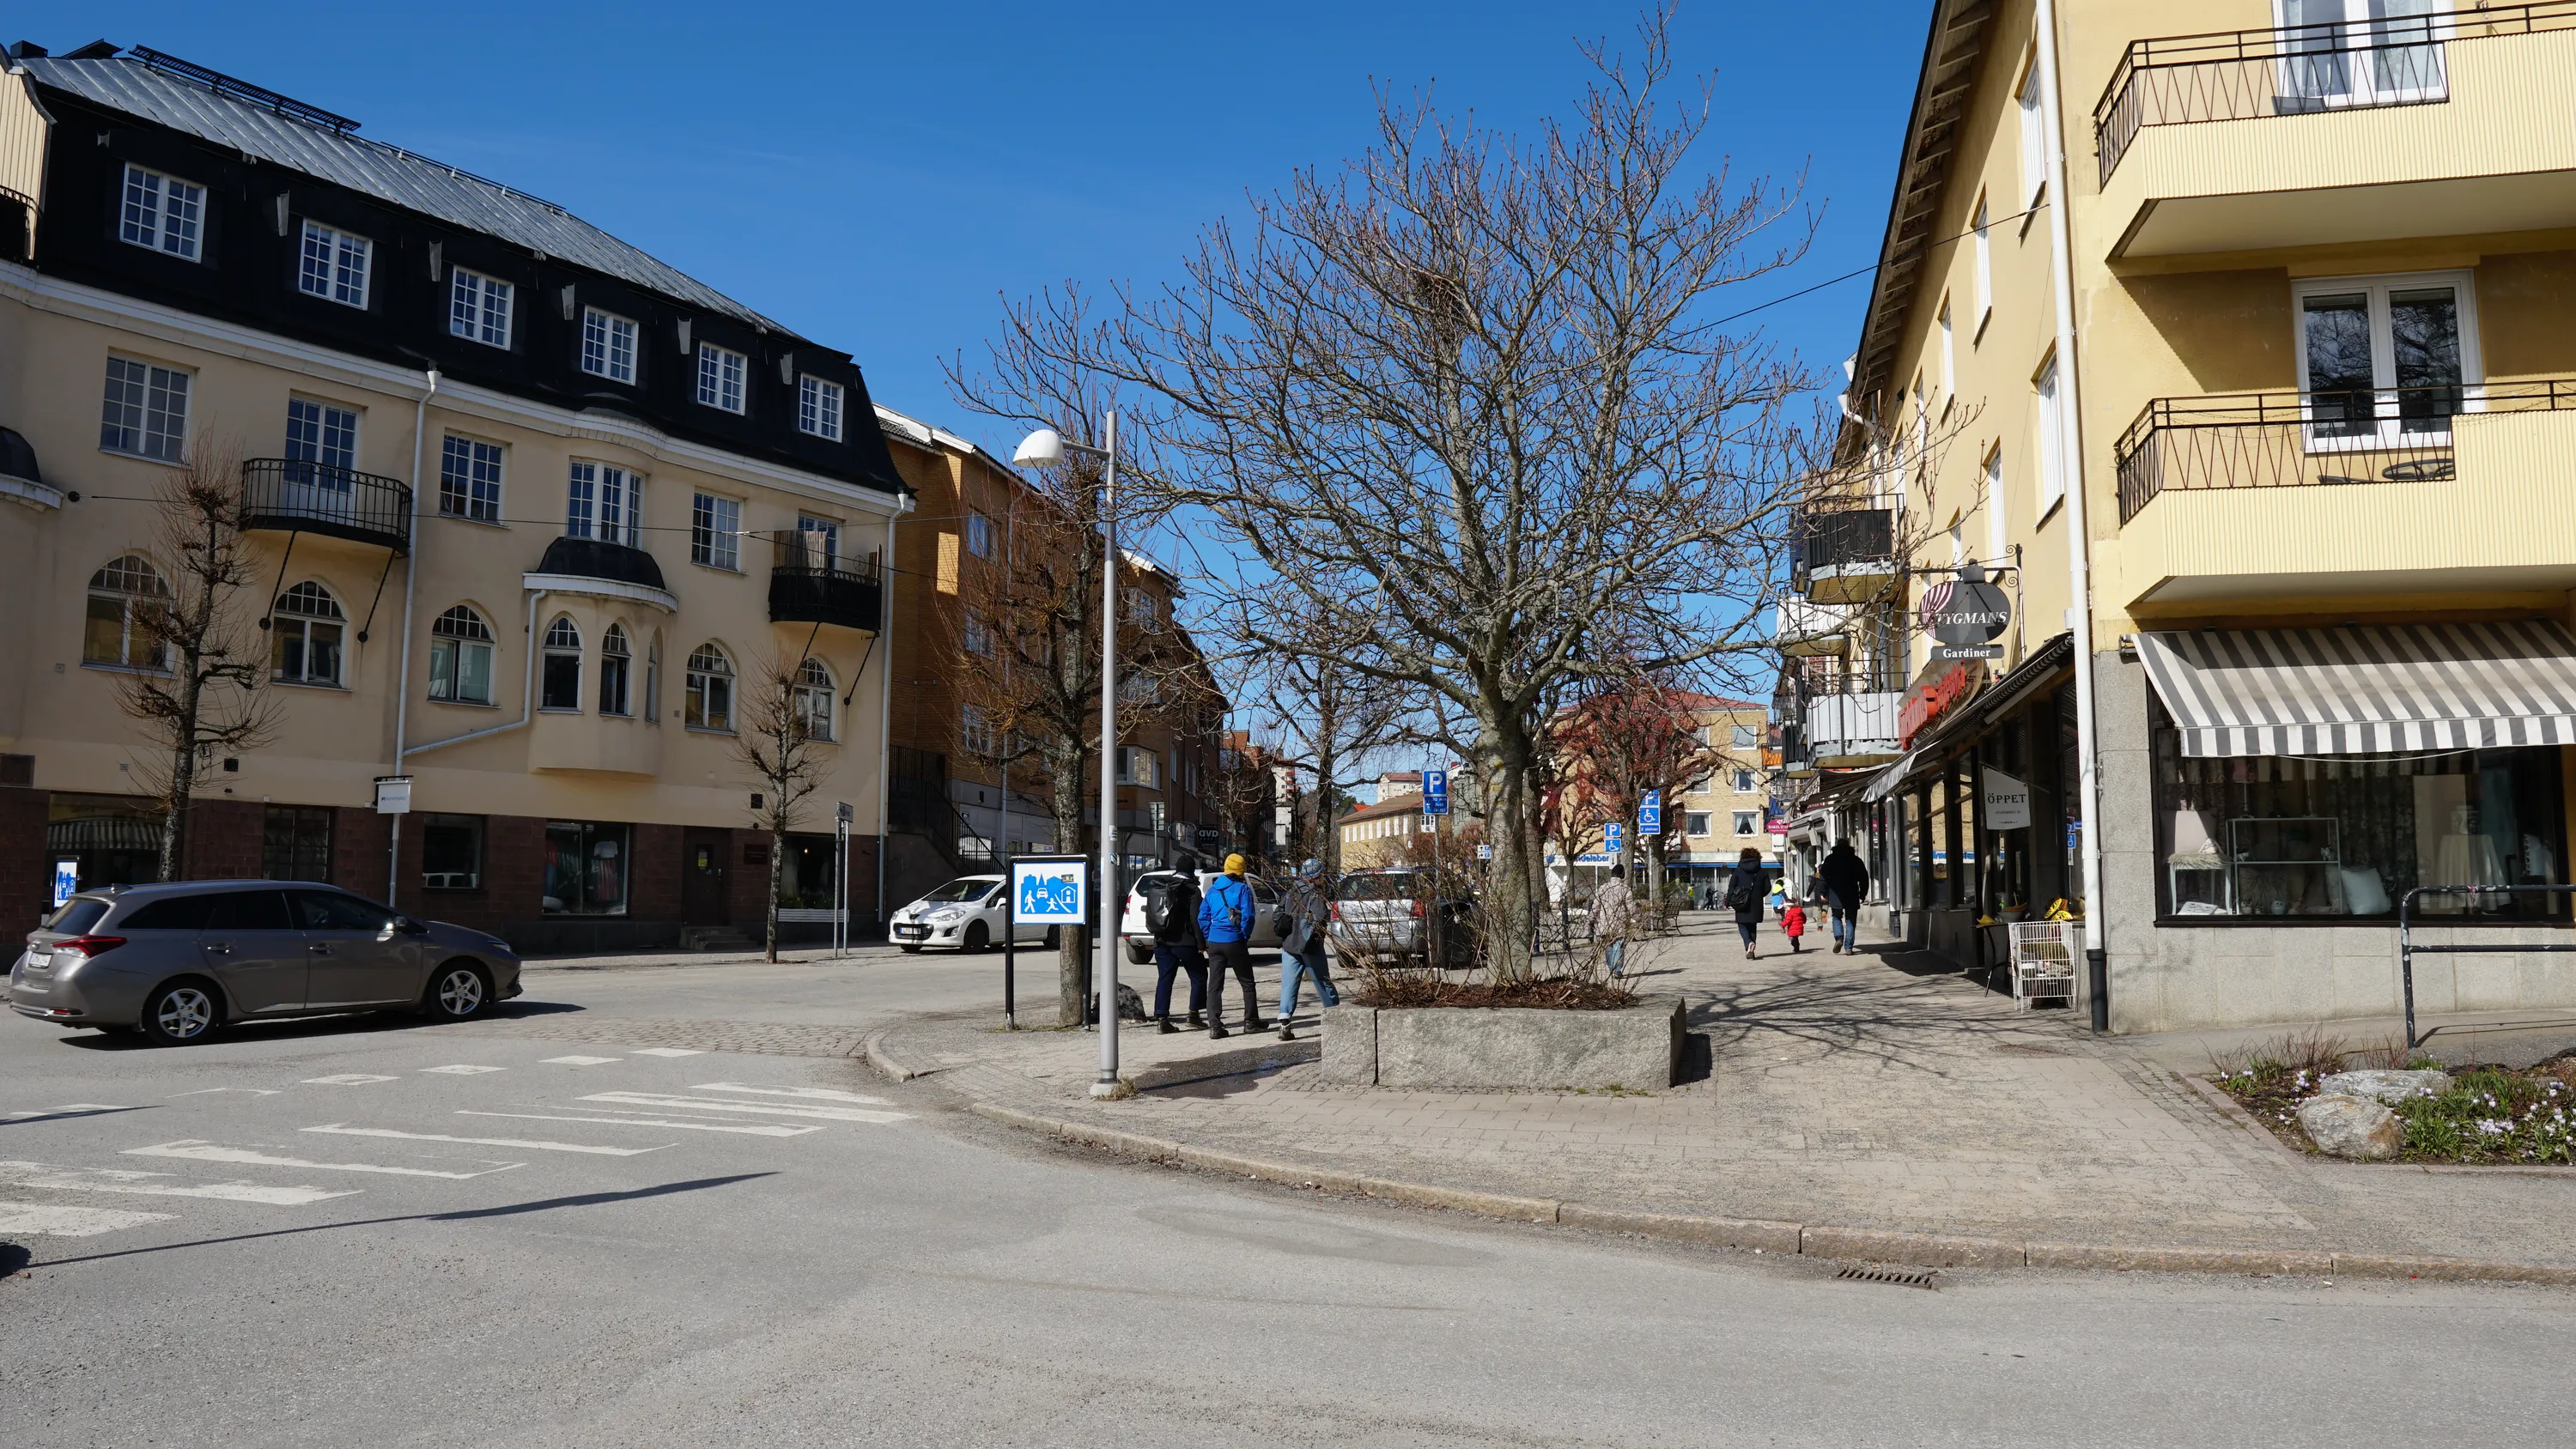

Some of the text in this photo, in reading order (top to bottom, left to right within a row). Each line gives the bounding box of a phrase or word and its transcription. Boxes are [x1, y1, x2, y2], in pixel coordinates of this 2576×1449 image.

[1942, 648, 1991, 658] Gardiner
[1429, 773, 1443, 793] P
[1987, 792, 2026, 804] ÖPPET
[1609, 824, 1618, 836] P
